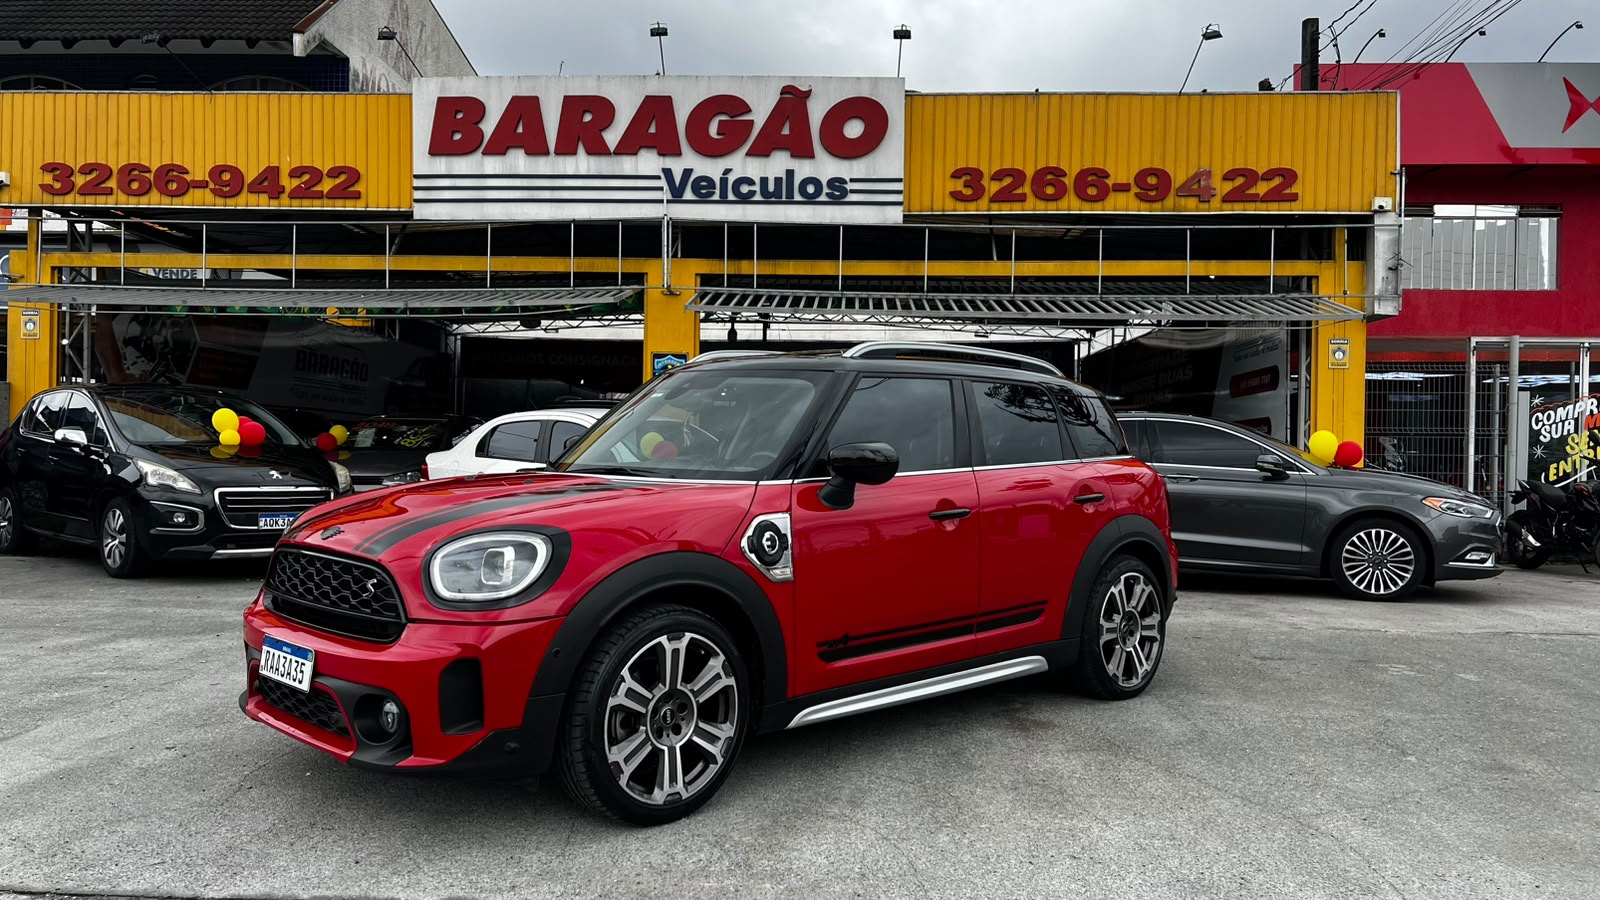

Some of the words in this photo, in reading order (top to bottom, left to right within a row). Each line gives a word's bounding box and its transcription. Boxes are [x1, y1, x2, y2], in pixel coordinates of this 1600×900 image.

[428, 84, 889, 159] BARAGÃO
[38, 161, 362, 200] 3266-9422
[661, 167, 850, 200] Veículos
[949, 166, 1299, 203] 3266-9422
[153, 268, 198, 279] VENDE
[1531, 397, 1600, 430] COMPR
[1539, 419, 1575, 443] SUA
[263, 650, 306, 685] RAA3A35
